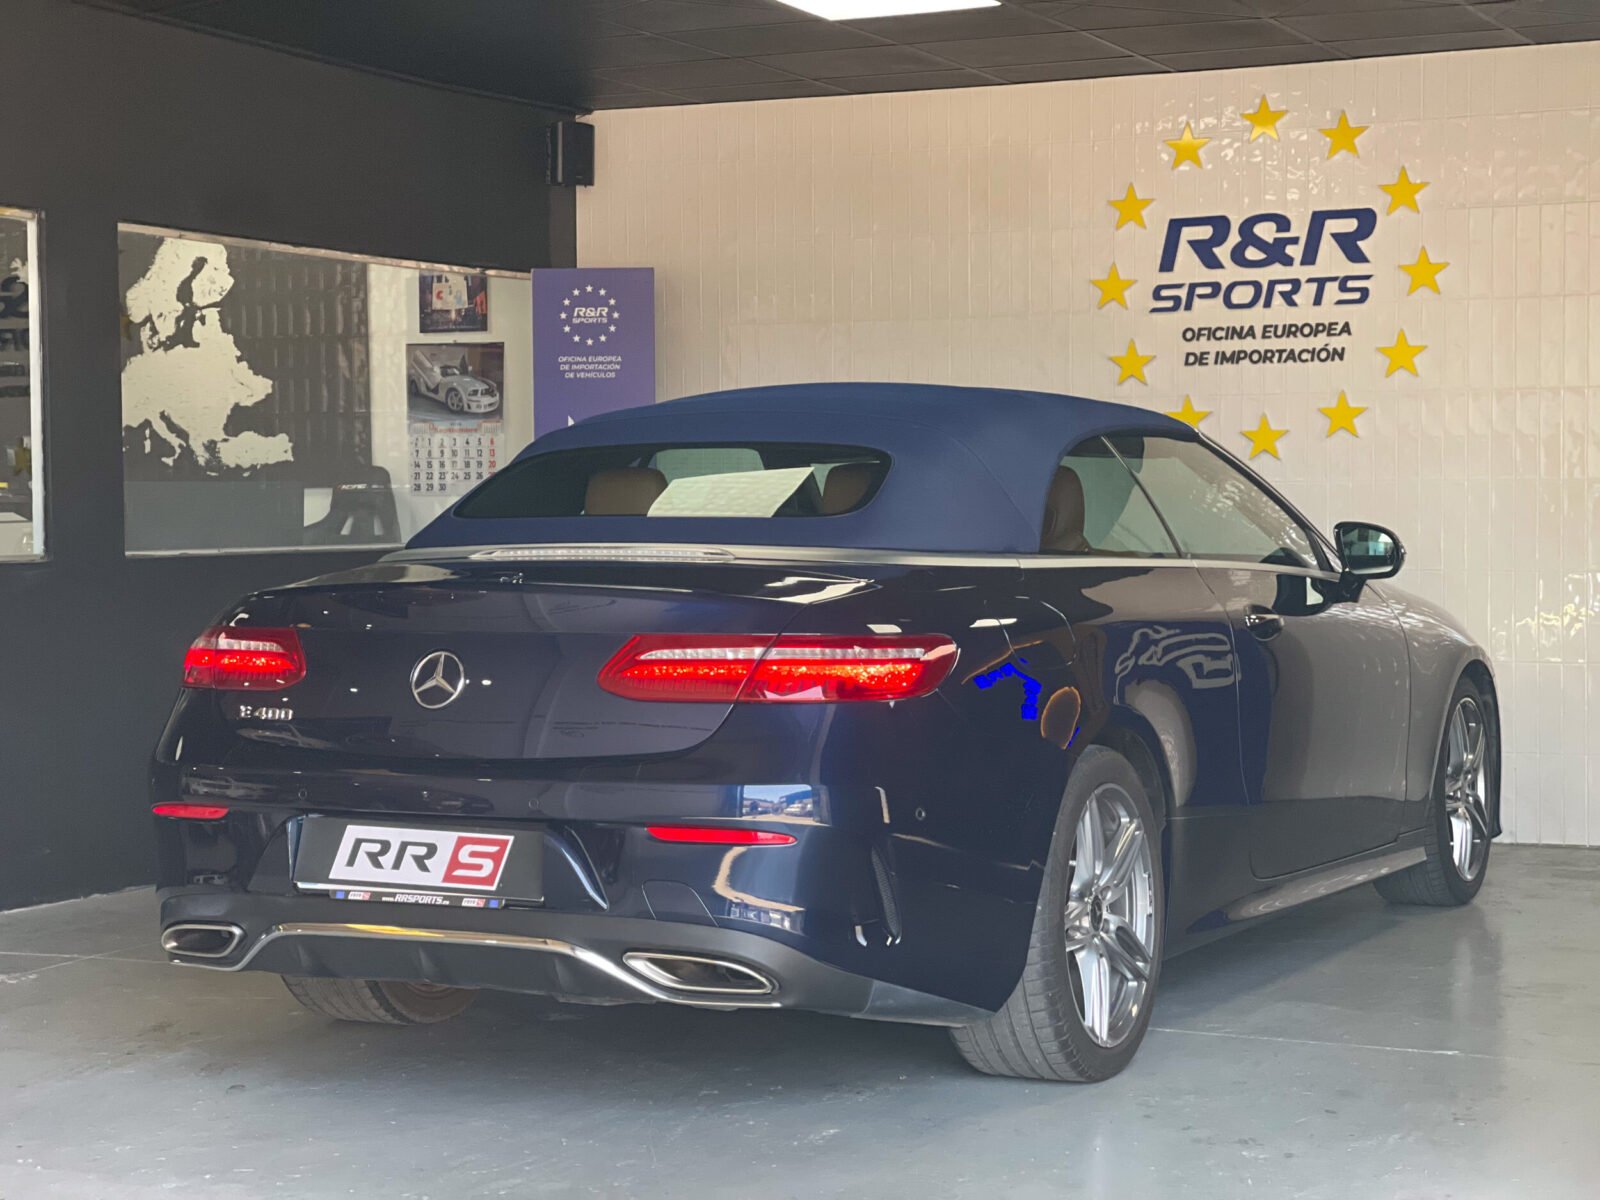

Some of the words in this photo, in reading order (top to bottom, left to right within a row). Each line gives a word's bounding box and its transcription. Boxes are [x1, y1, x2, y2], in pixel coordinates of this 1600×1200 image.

[1158, 207, 1378, 273] R&R
[1149, 274, 1375, 314] SPORTS
[573, 307, 609, 317] R&R
[1182, 326, 1256, 342] OFICINA
[1261, 321, 1352, 340] EUROPEA
[1184, 351, 1210, 367] DE
[1214, 343, 1346, 365] IMPORTACIÓN
